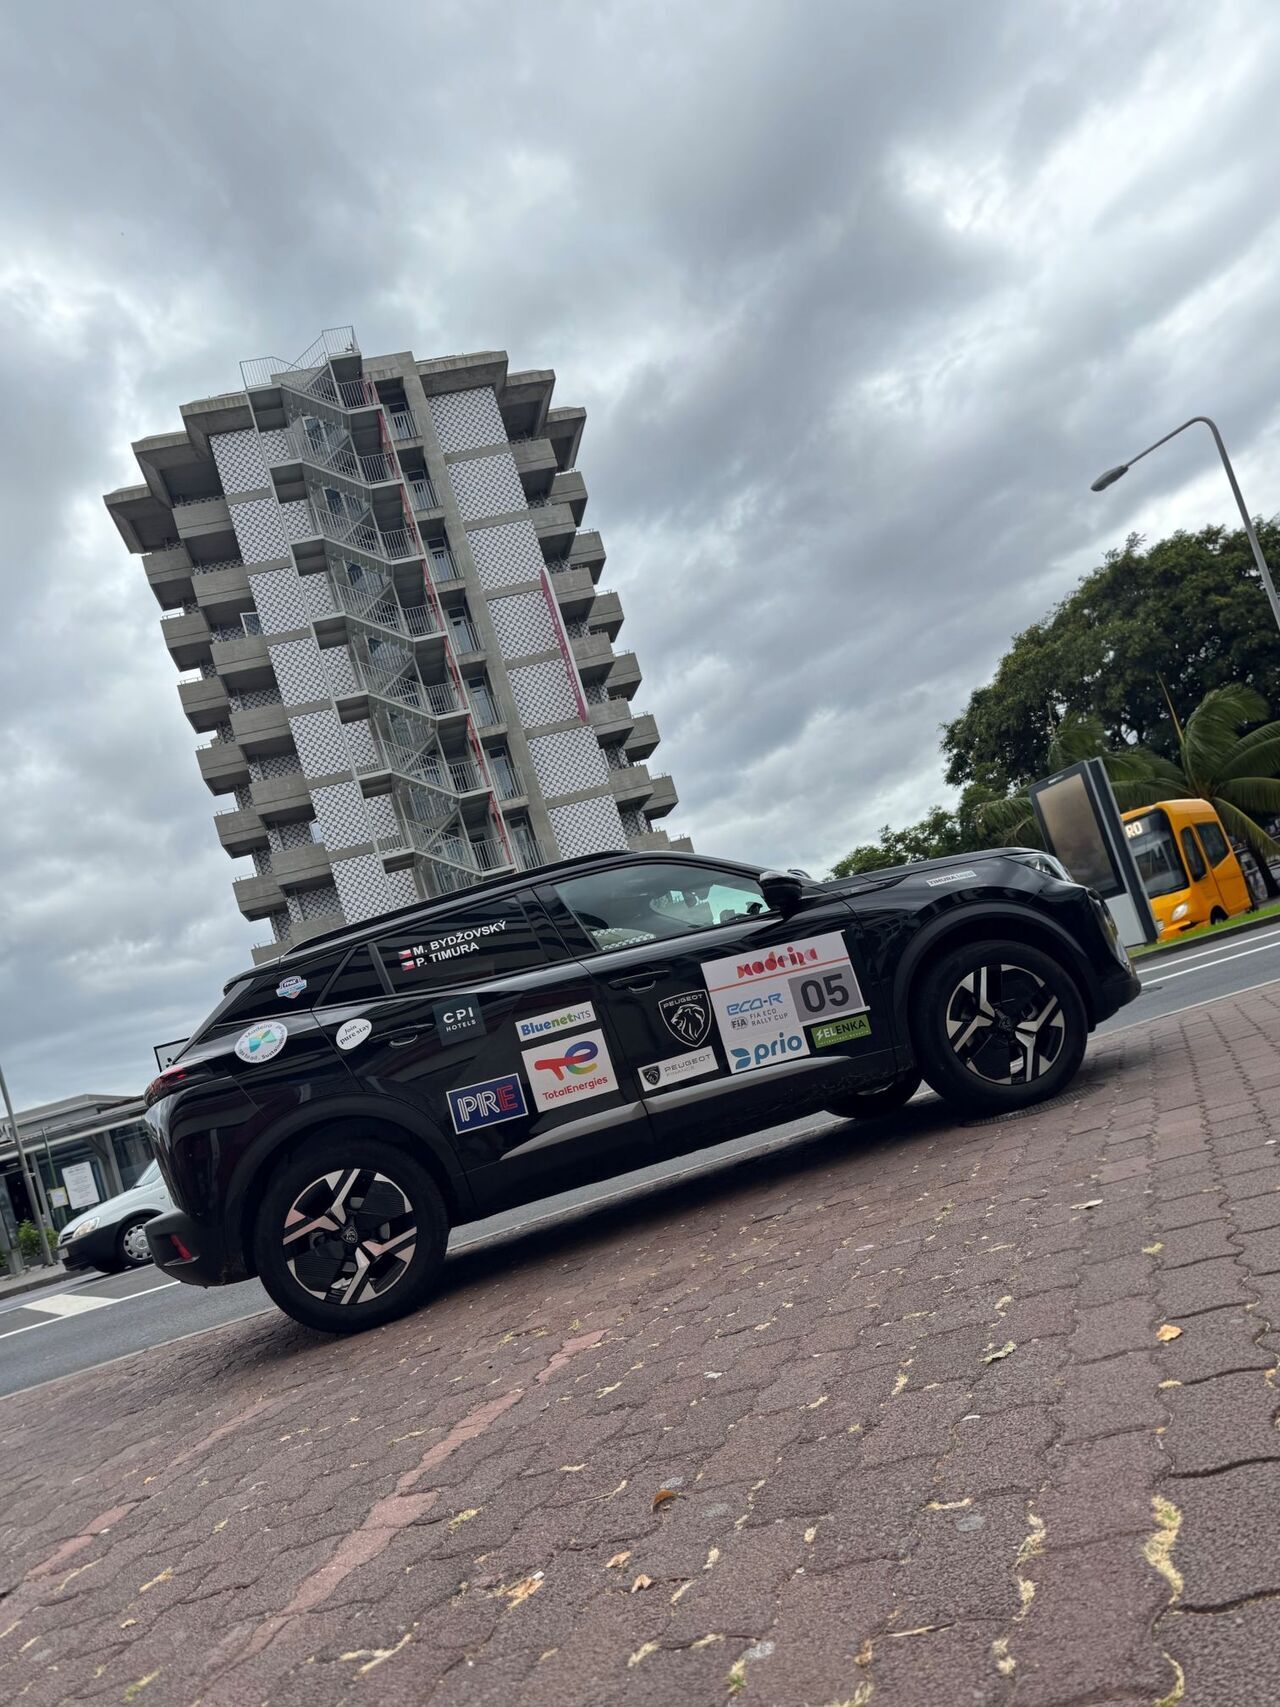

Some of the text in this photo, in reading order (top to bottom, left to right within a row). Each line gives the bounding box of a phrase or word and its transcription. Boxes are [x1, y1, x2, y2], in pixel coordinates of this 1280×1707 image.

[412, 919, 507, 956] M. BYDŽOVSKÝ
[416, 942, 480, 967] P. TIMURA
[663, 993, 703, 1008] PEUGEOT
[801, 973, 850, 1013] 05
[442, 1006, 474, 1024] CPI
[750, 1008, 777, 1020] FIA ECO
[751, 1012, 789, 1026] RALLY CUP
[340, 1025, 369, 1045] pure stay
[446, 1019, 476, 1032] HOTELS
[754, 1032, 803, 1065] prio
[664, 1054, 711, 1073] PEUGEOT
[542, 1076, 608, 1101] TotalEnergies
[457, 1083, 518, 1122] PRE
